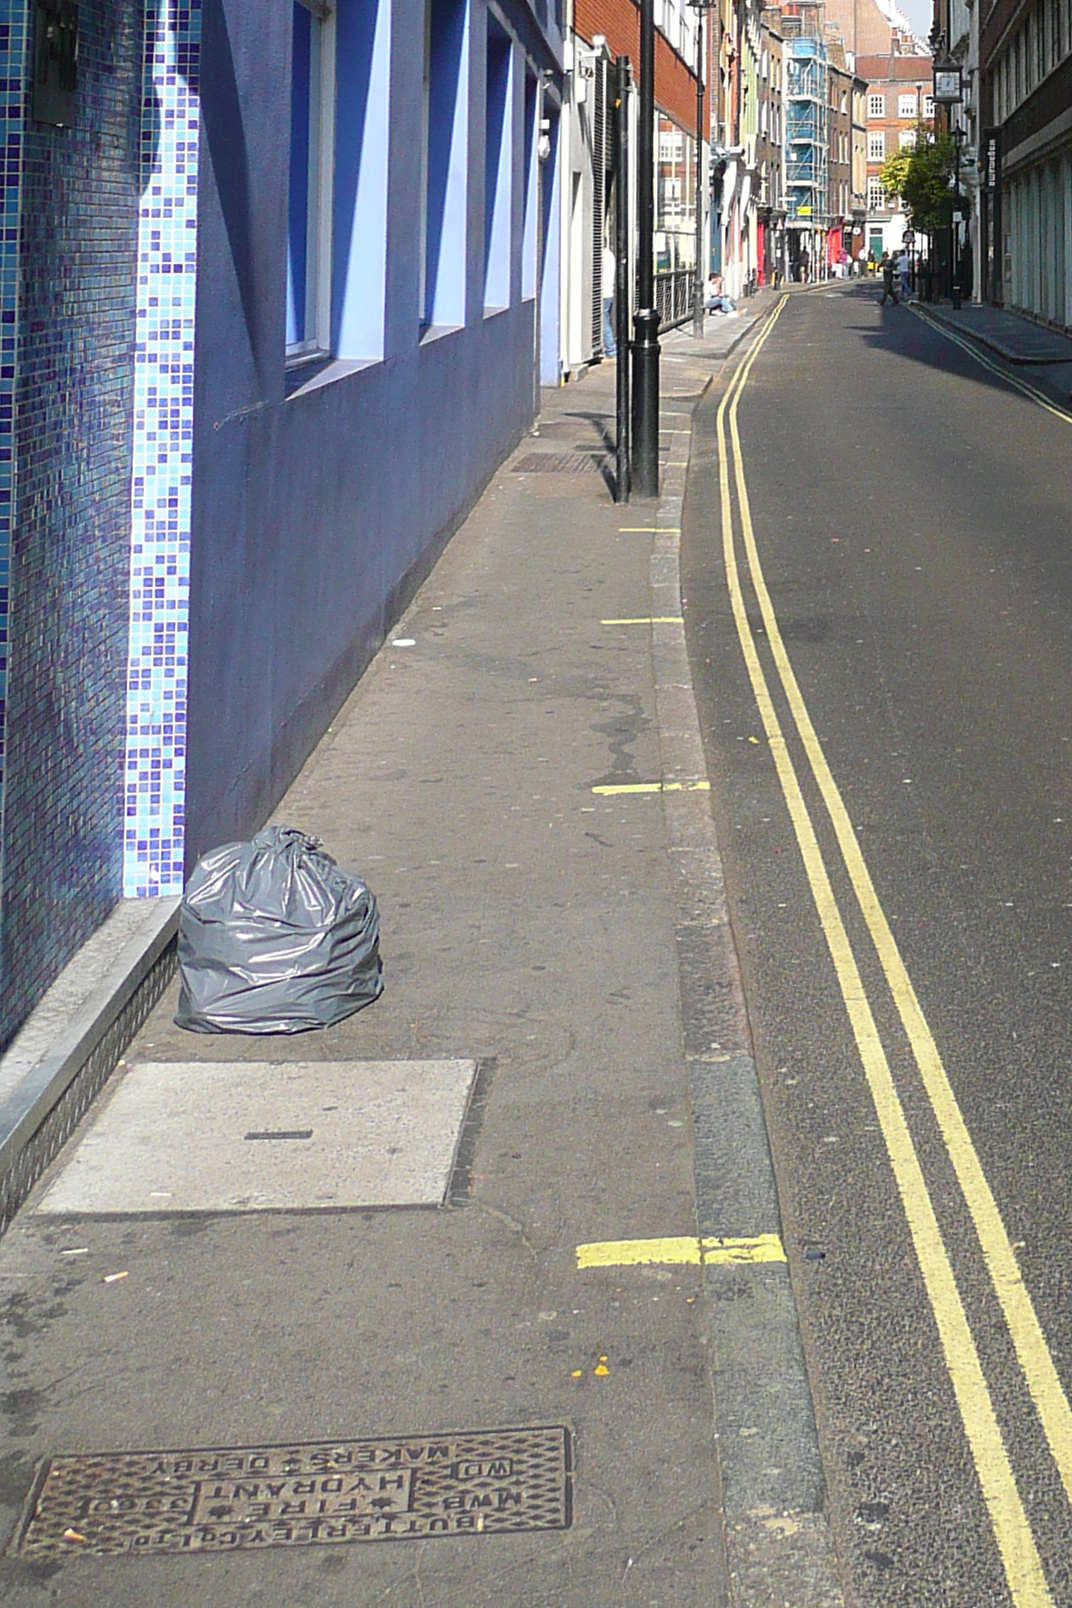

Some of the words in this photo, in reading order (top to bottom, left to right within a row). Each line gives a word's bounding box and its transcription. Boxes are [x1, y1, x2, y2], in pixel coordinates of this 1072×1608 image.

[310, 1446, 449, 1466] MAKERS
[151, 1457, 269, 1476] DERBY
[464, 1462, 508, 1475] WD
[205, 1475, 404, 1499] HYDRANT
[248, 1498, 357, 1517] FIRE
[442, 1492, 522, 1511] MWB
[249, 1516, 475, 1544] BUTTERLEY
